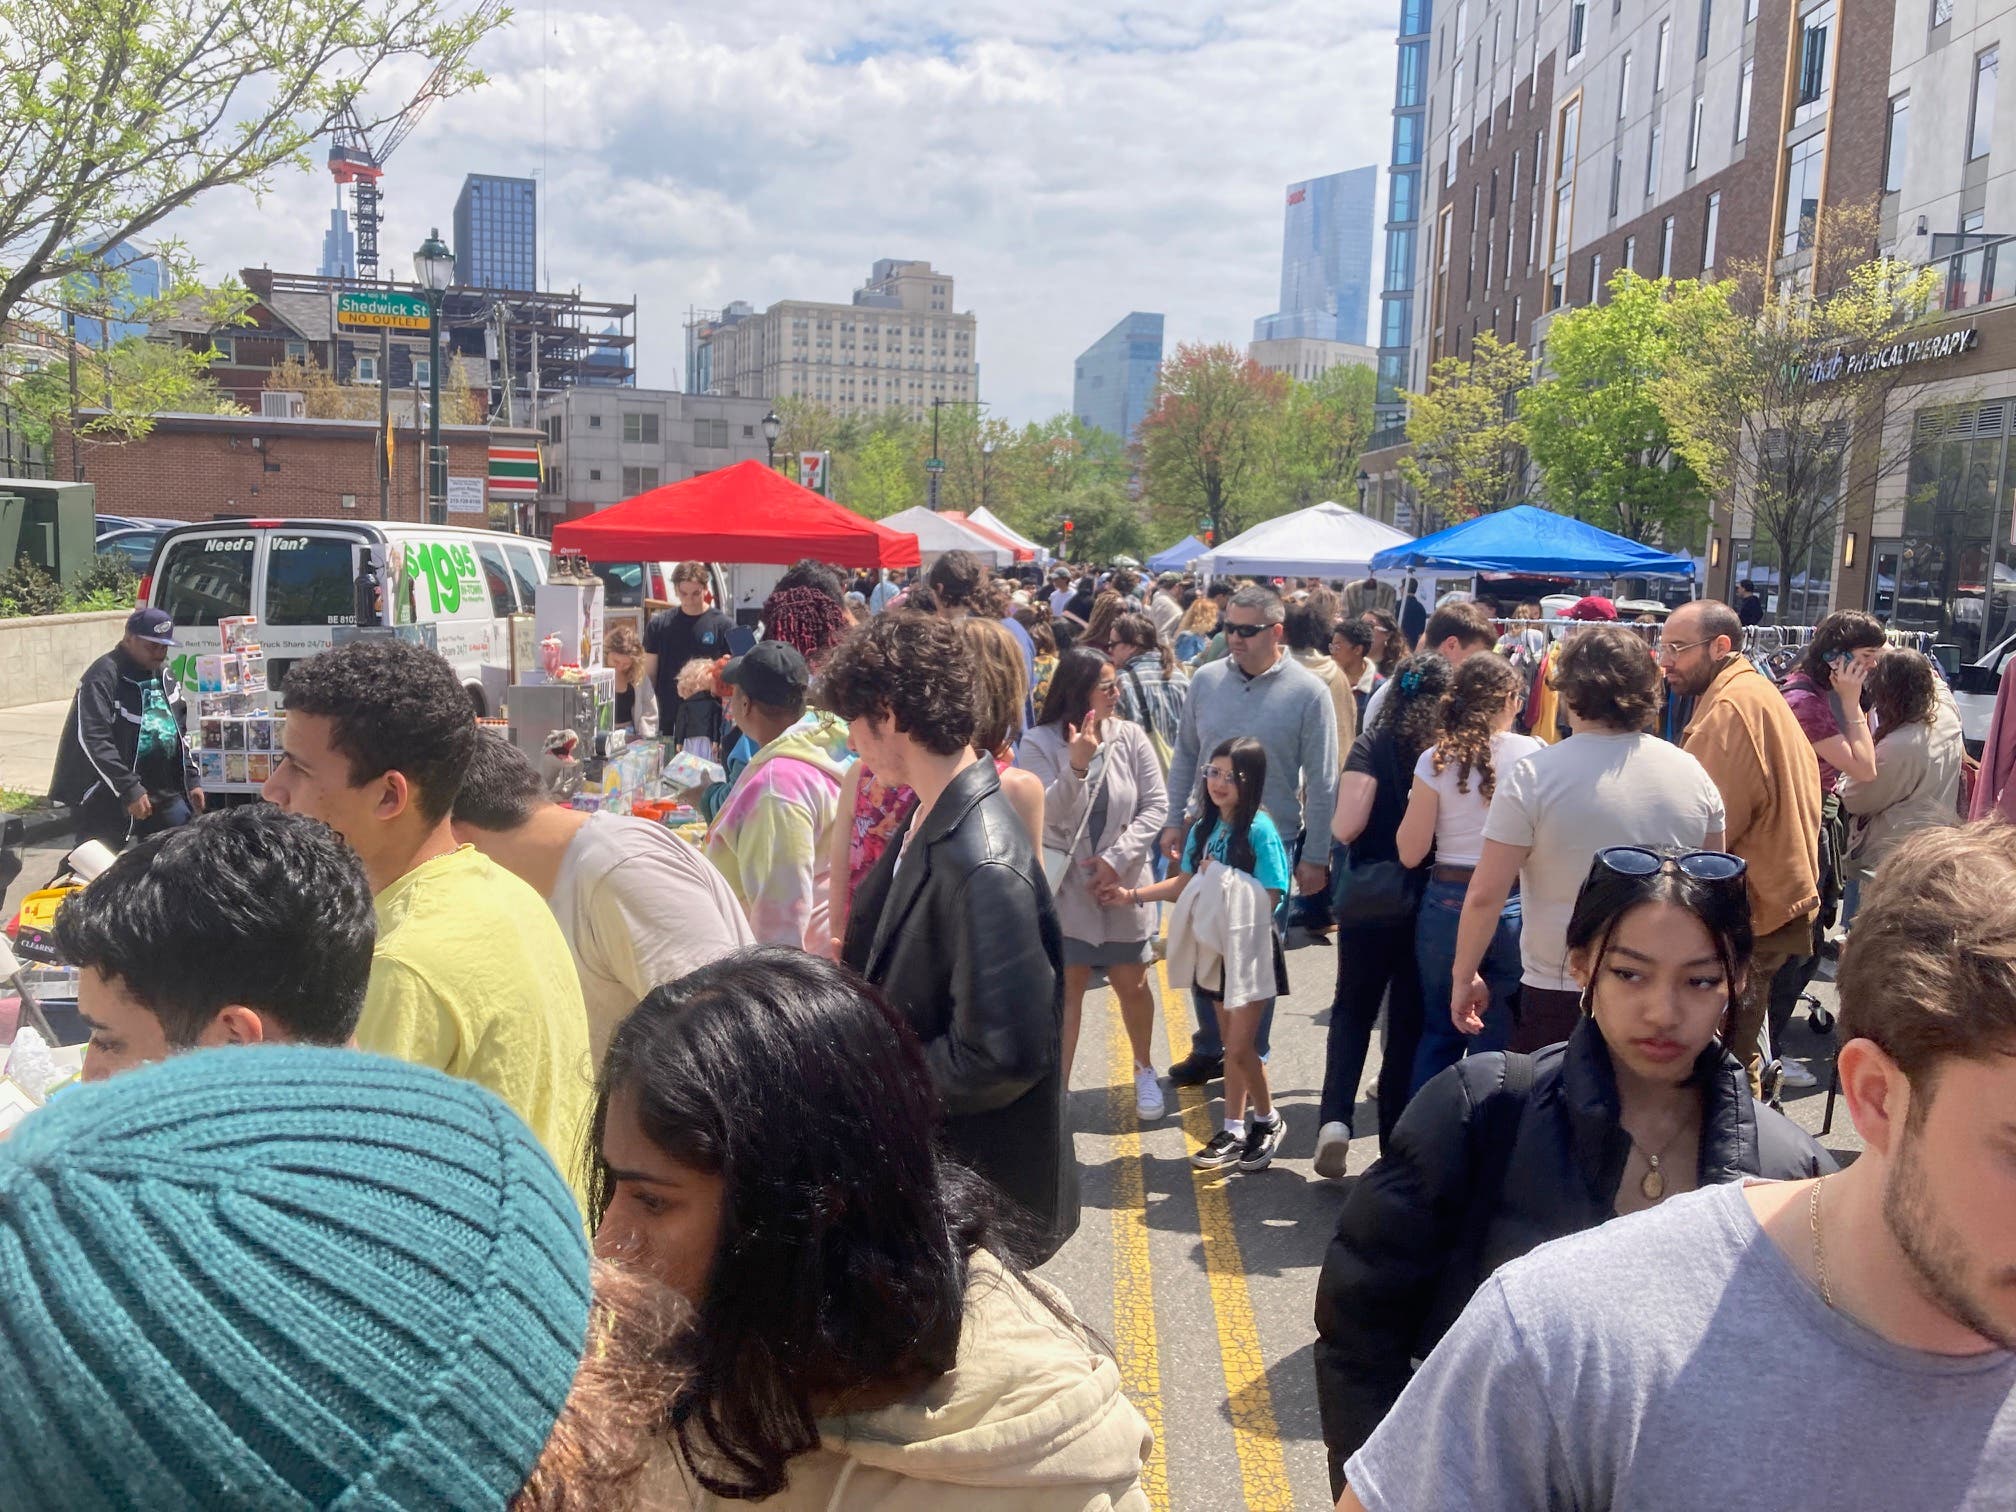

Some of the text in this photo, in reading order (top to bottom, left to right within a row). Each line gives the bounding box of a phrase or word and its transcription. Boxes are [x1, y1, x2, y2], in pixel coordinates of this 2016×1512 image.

[342, 298, 427, 318] Shedwick St
[349, 313, 419, 327] NO OUTLET
[1905, 329, 1971, 363] THERAPY
[204, 537, 308, 552] Need a Van?
[327, 615, 338, 624] BE
[260, 640, 280, 648] Truck
[283, 640, 305, 648] Share
[307, 640, 325, 648] 24/7
